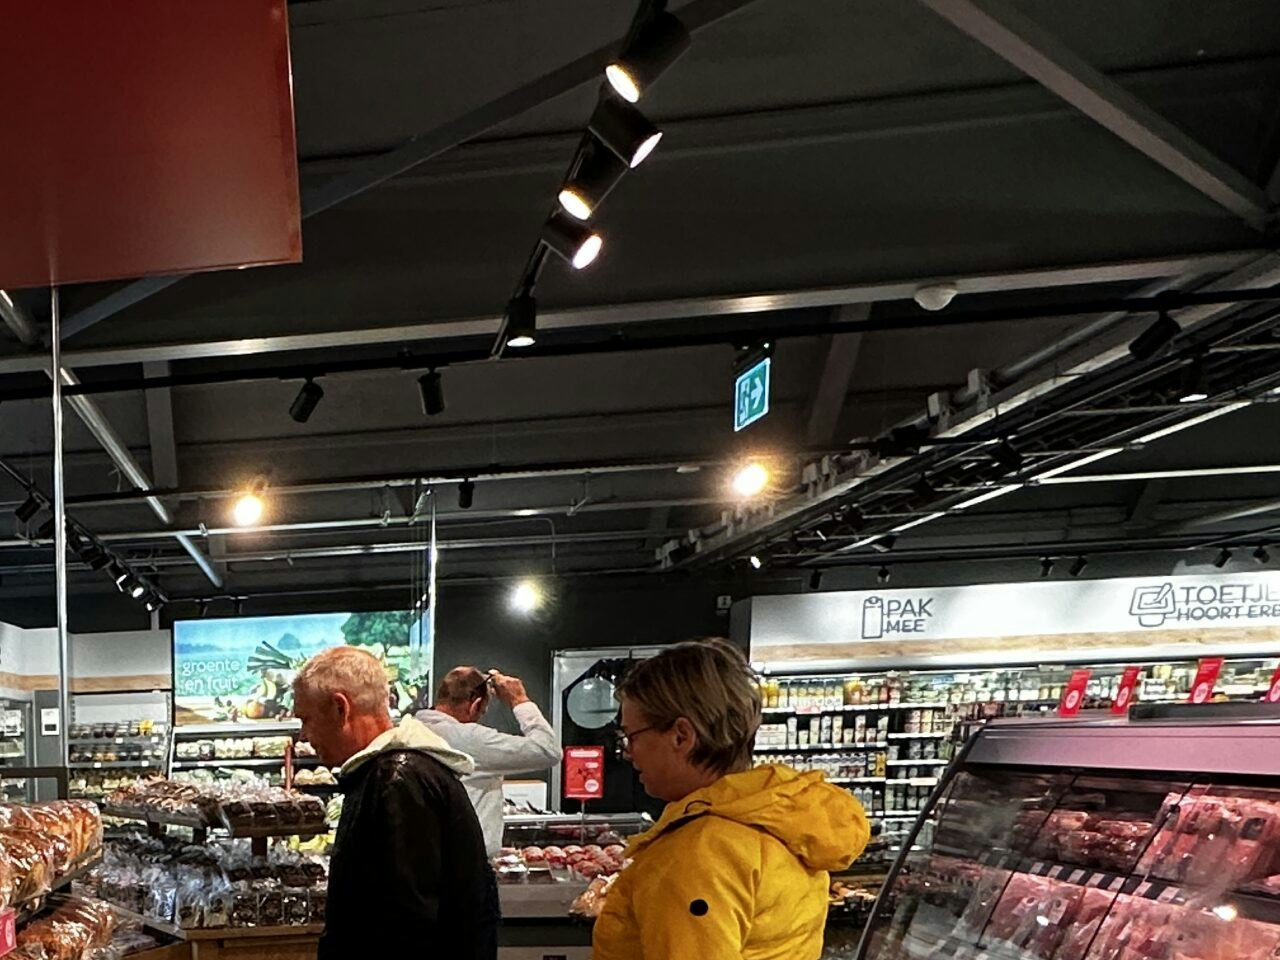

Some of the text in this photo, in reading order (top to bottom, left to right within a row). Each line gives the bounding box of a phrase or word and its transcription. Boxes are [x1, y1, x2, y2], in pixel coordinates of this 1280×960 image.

[886, 597, 934, 618] PAK
[1176, 604, 1243, 621] HOORT
[886, 618, 926, 633] MEE
[182, 658, 241, 677] groente
[184, 675, 239, 692] en fruit
